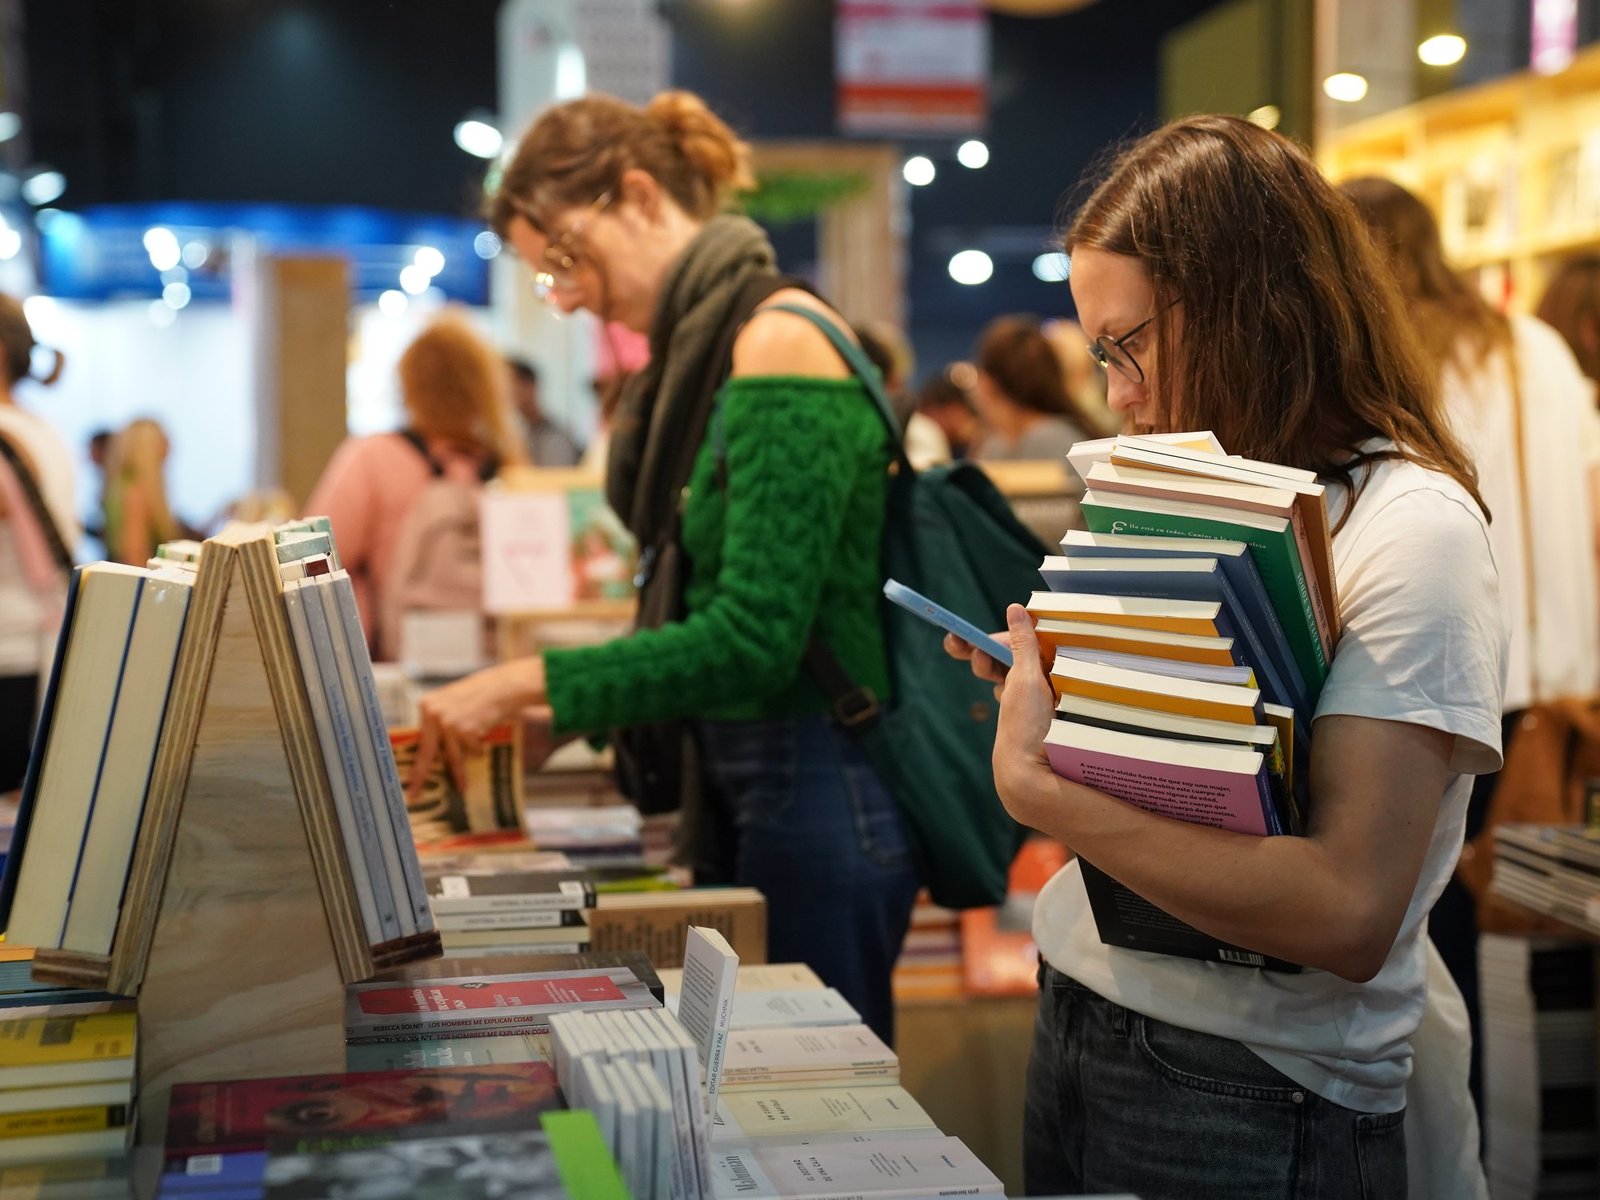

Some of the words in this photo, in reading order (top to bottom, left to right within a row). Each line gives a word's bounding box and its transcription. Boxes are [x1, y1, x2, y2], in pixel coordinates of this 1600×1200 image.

[1111, 774, 1142, 785] instantes
[1116, 769, 1137, 777] olvido
[1137, 773, 1157, 781] hasta
[1110, 787, 1133, 795] cuerpo
[1189, 801, 1213, 809] cuerpo
[1170, 804, 1194, 812] cuerpo
[1185, 812, 1210, 820] cuerpo
[720, 998, 729, 1028] MUCHNIK
[373, 1024, 400, 1032] REBECCA
[441, 1019, 472, 1027] HOMBRES
[484, 1016, 512, 1025] EXPLICAN
[513, 1015, 534, 1023] COSAS
[499, 1029, 530, 1037] EXPLICAN
[712, 1050, 721, 1070] GUERRA
[709, 1073, 718, 1094] EDITAR
